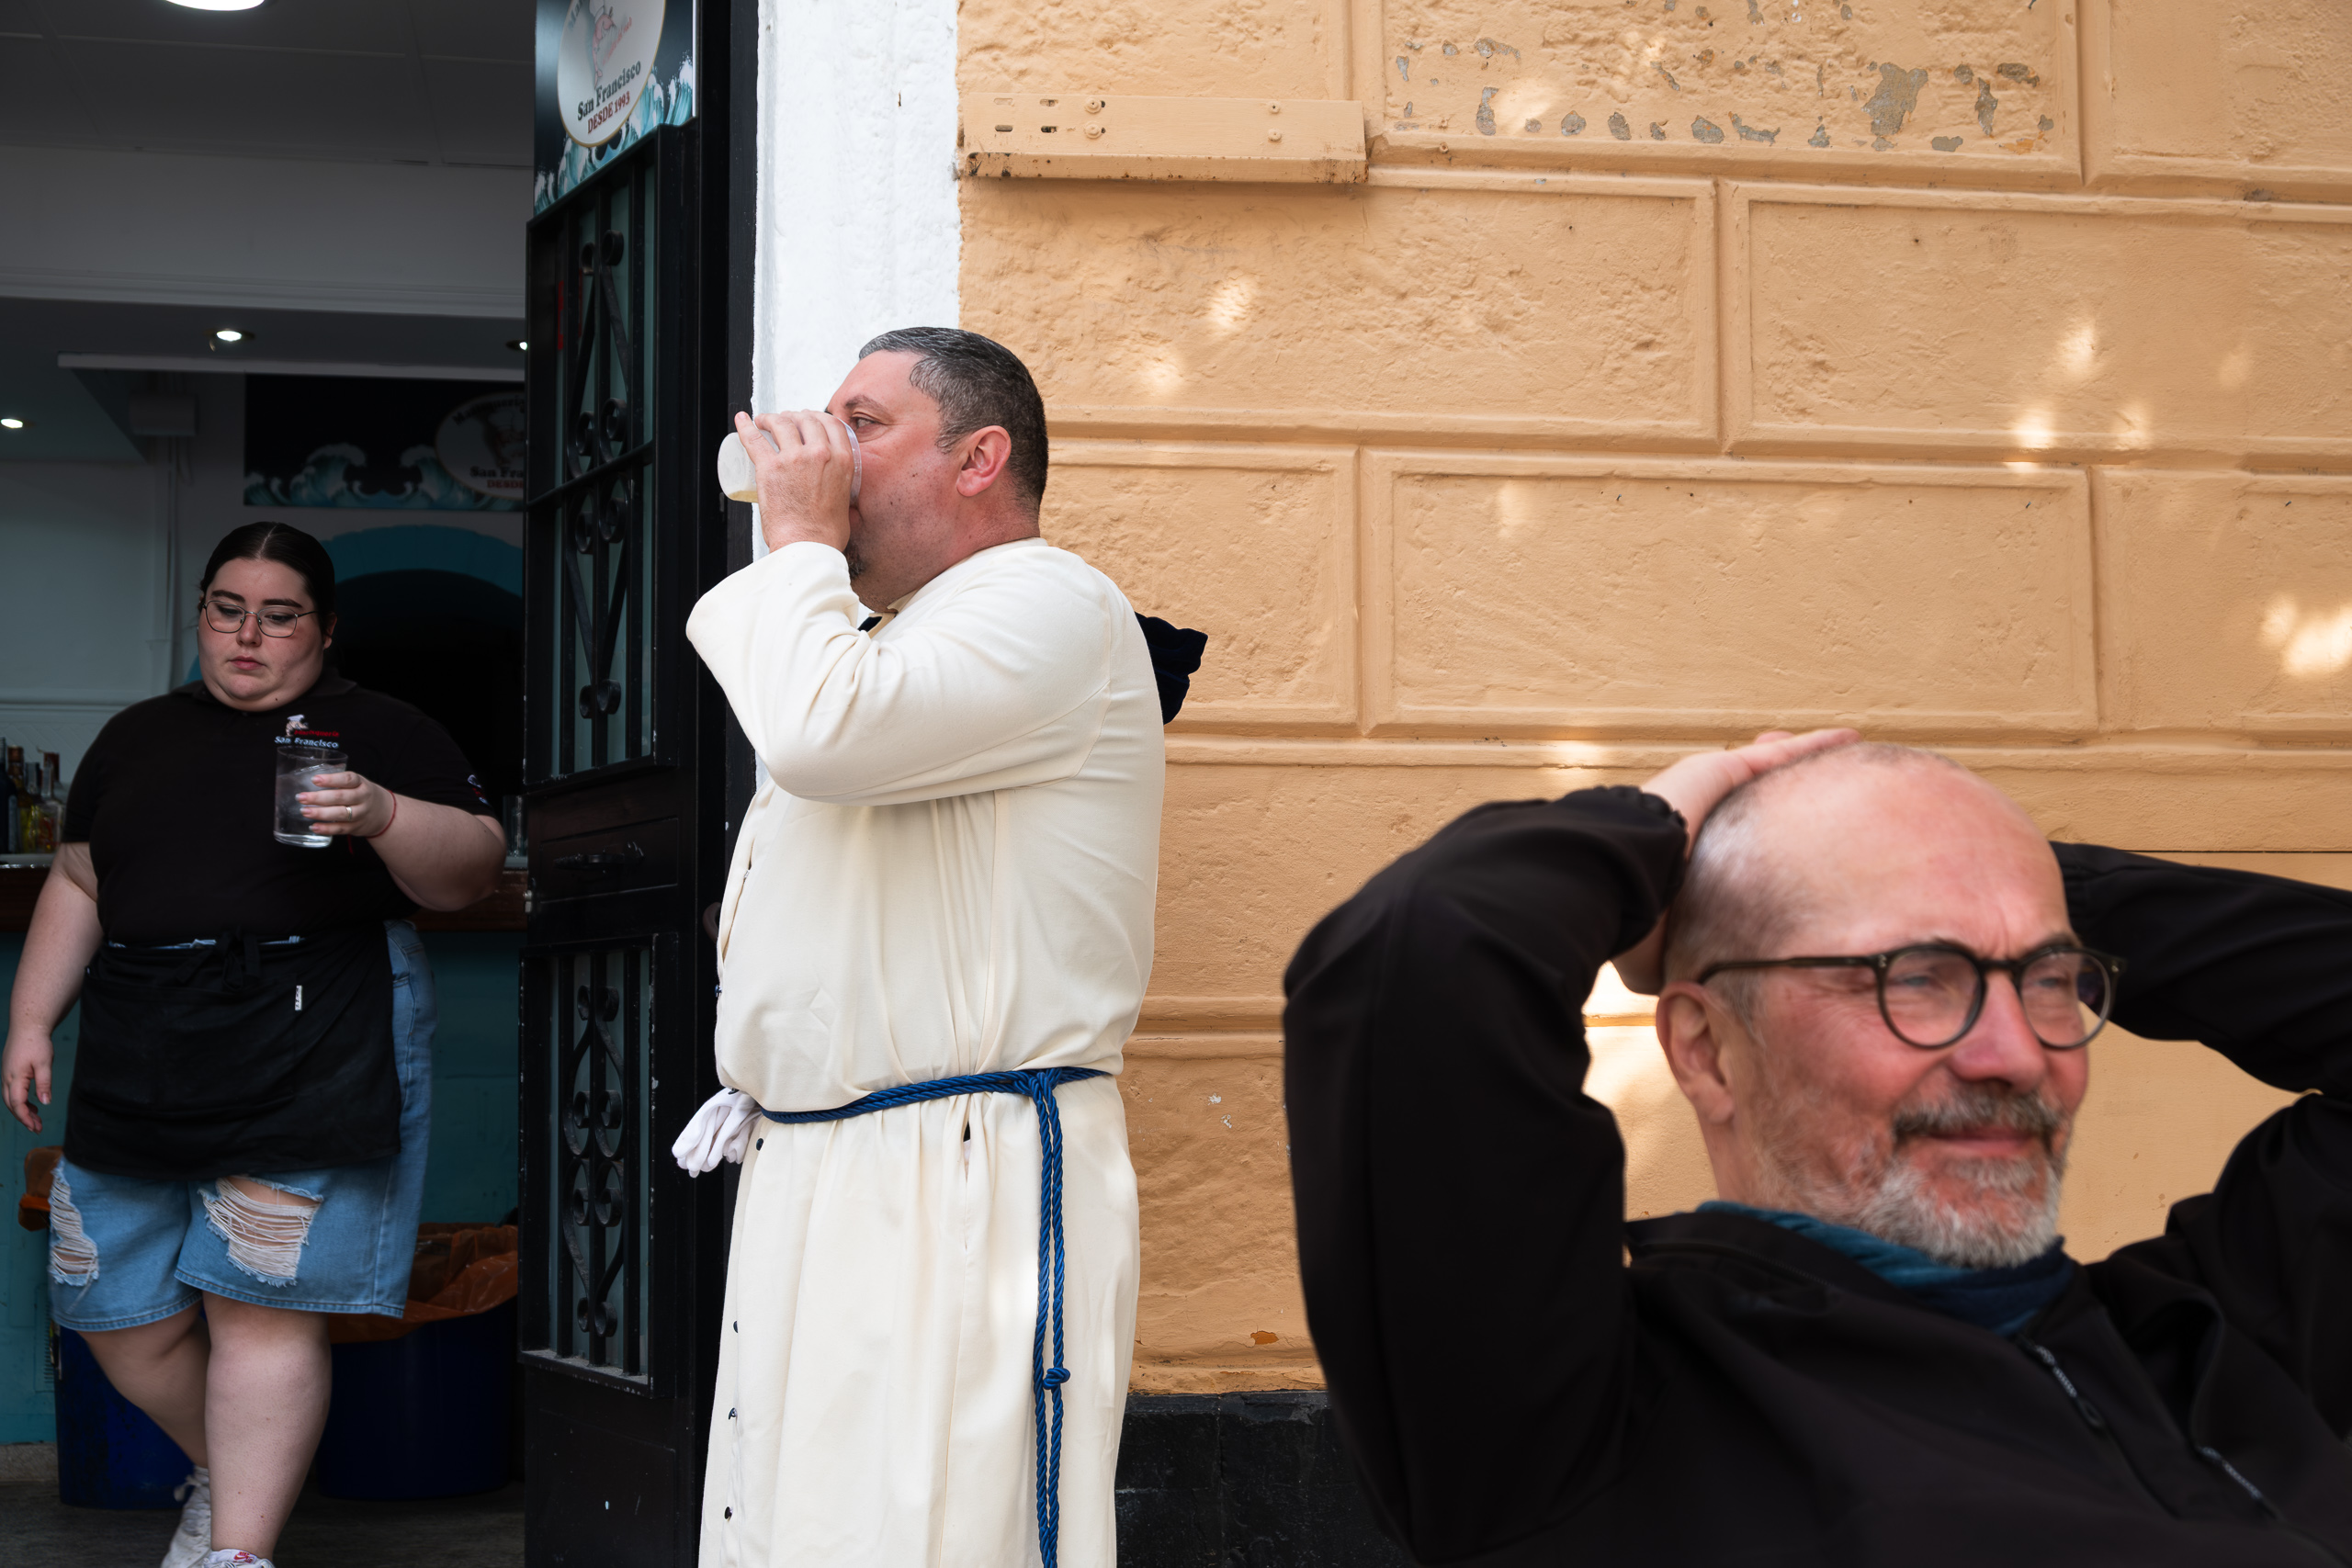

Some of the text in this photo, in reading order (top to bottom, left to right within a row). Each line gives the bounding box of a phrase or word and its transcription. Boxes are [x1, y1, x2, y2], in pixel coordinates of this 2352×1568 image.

[577, 61, 641, 121] San Francisco
[587, 91, 630, 134] DESDE 1993
[469, 466, 496, 478] San
[275, 736, 340, 749] San Francisco
